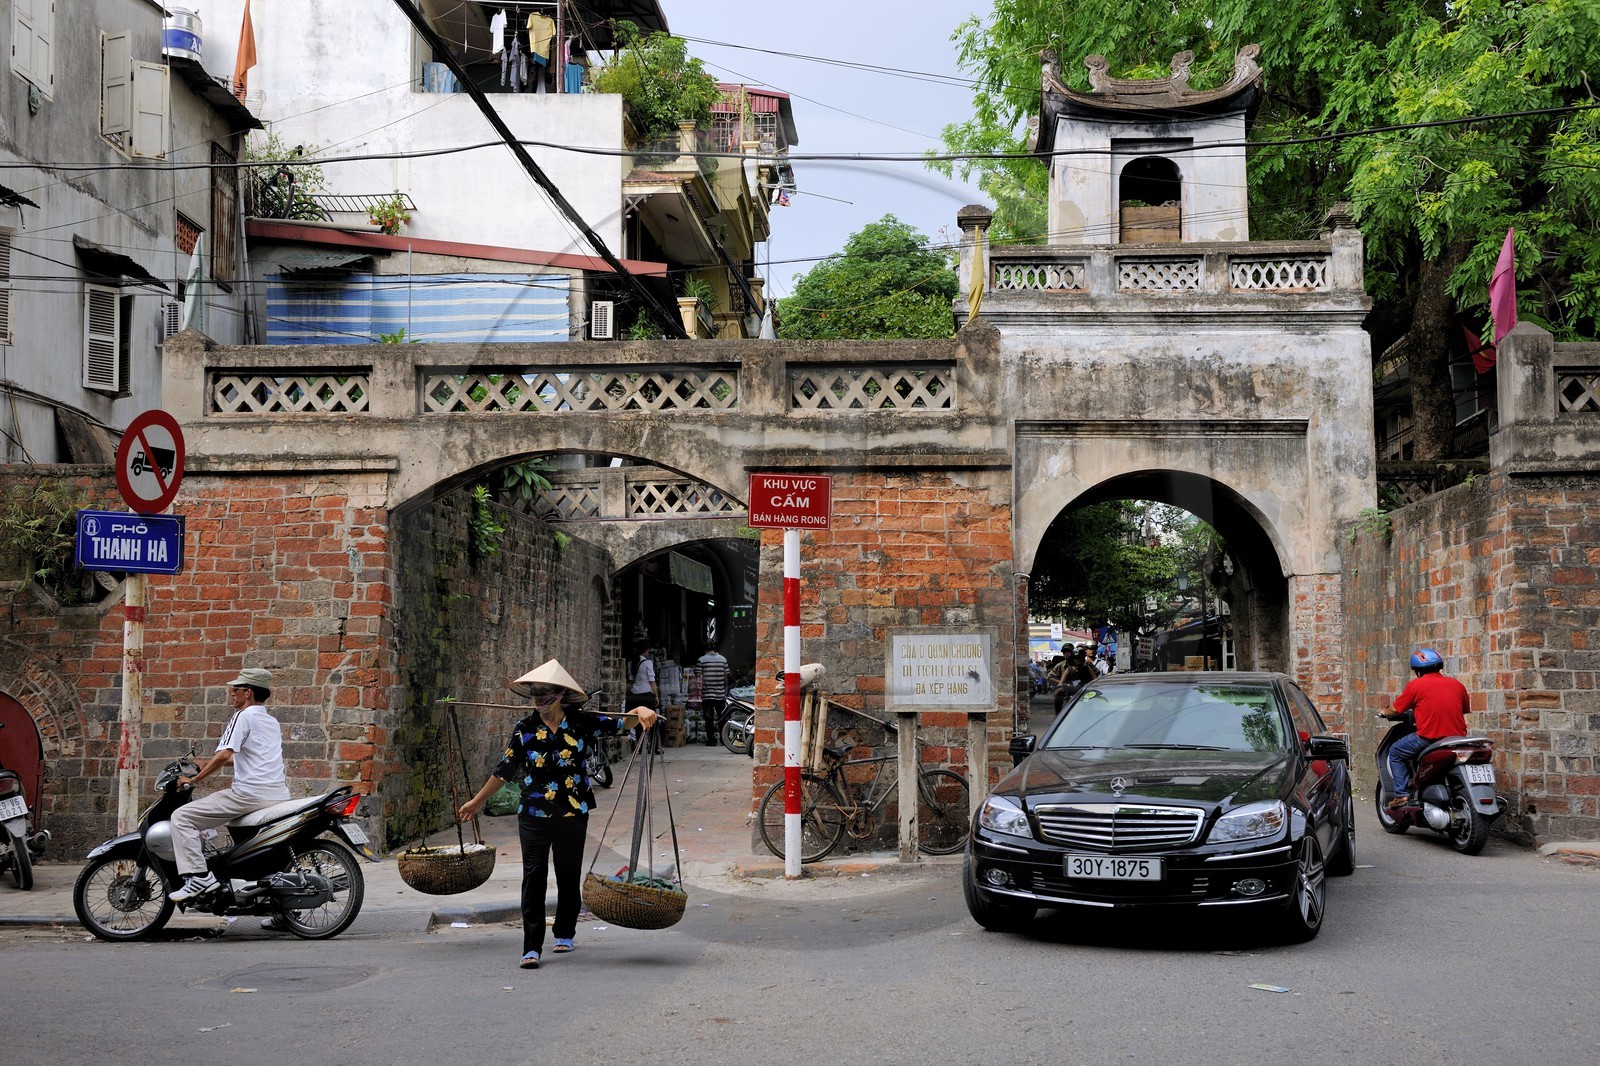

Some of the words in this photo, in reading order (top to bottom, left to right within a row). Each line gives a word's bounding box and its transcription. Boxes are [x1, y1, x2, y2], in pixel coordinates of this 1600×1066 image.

[763, 479, 788, 489] KHU
[792, 479, 816, 492] VỰC
[770, 492, 810, 508] CẤM
[753, 512, 771, 522] BÁN
[773, 512, 798, 523] HÀNG
[801, 515, 826, 524] RONG
[111, 523, 148, 534] PHỐ
[91, 536, 141, 561] THANH
[147, 537, 168, 562] HÀ
[927, 644, 948, 659] QUAN
[947, 682, 968, 696] HẠNG
[1472, 773, 1492, 782] 0510
[1073, 858, 1149, 878] 30Y-1875
